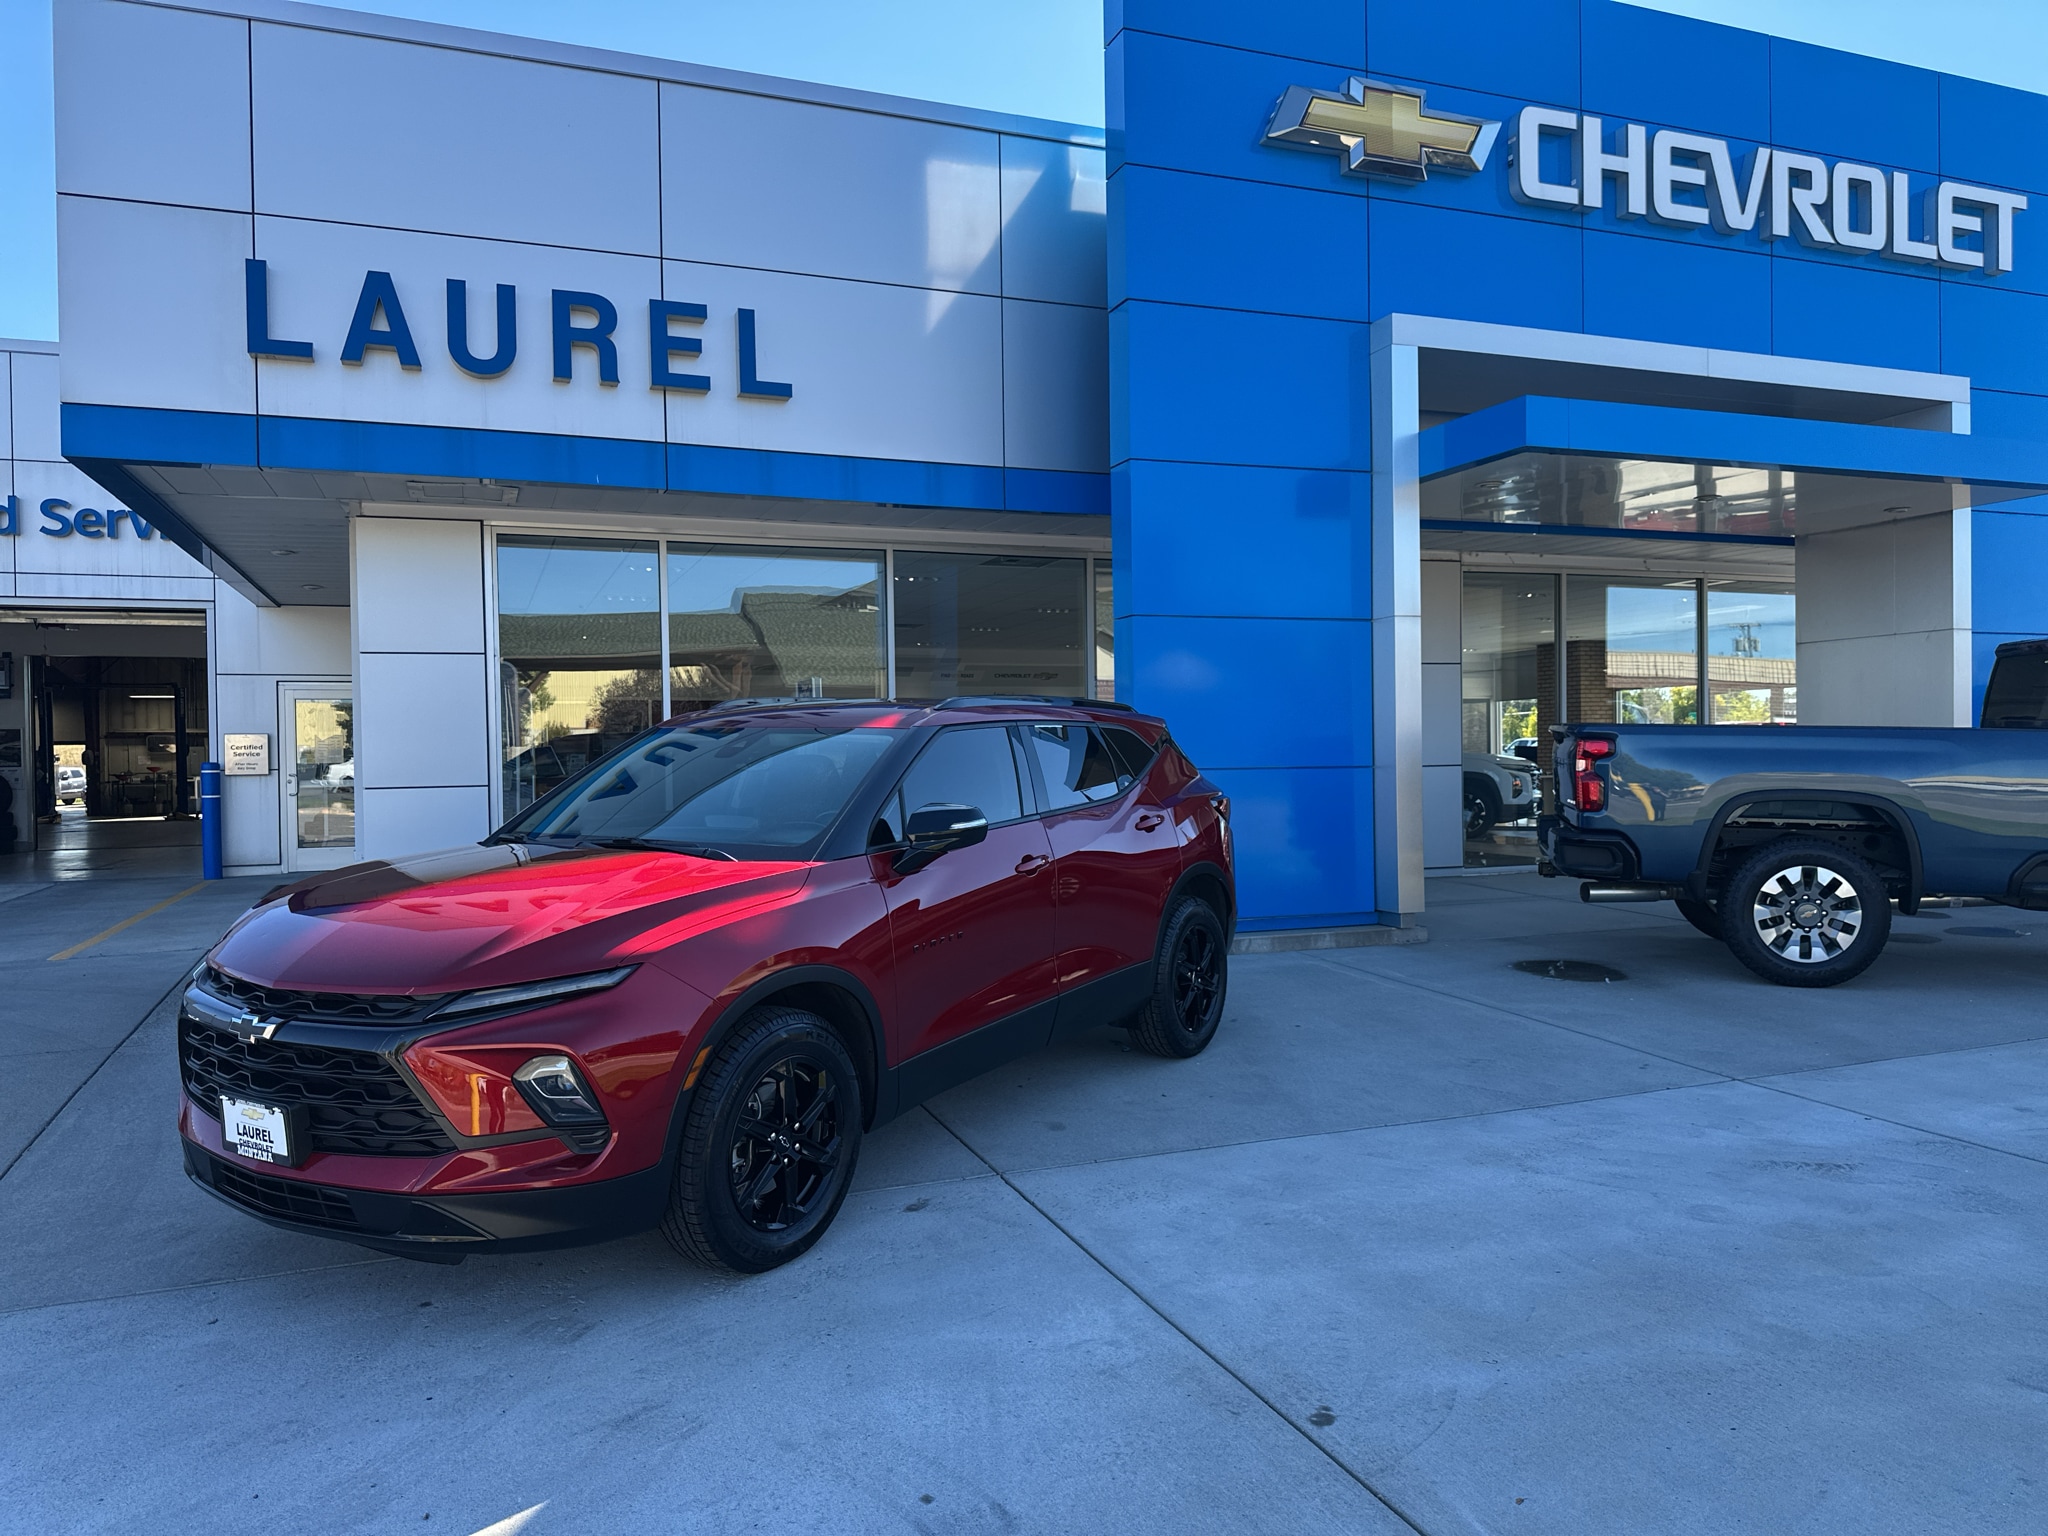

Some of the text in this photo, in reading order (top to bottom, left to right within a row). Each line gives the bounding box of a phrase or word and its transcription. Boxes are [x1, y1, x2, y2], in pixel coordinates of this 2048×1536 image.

[1511, 105, 2028, 274] CHEVROLET
[245, 257, 793, 401] LAUREL
[39, 498, 171, 540] Serv
[236, 1122, 274, 1144] LAUREL
[238, 1138, 273, 1153] CHEVROLET
[237, 1144, 274, 1163] MONTANA
